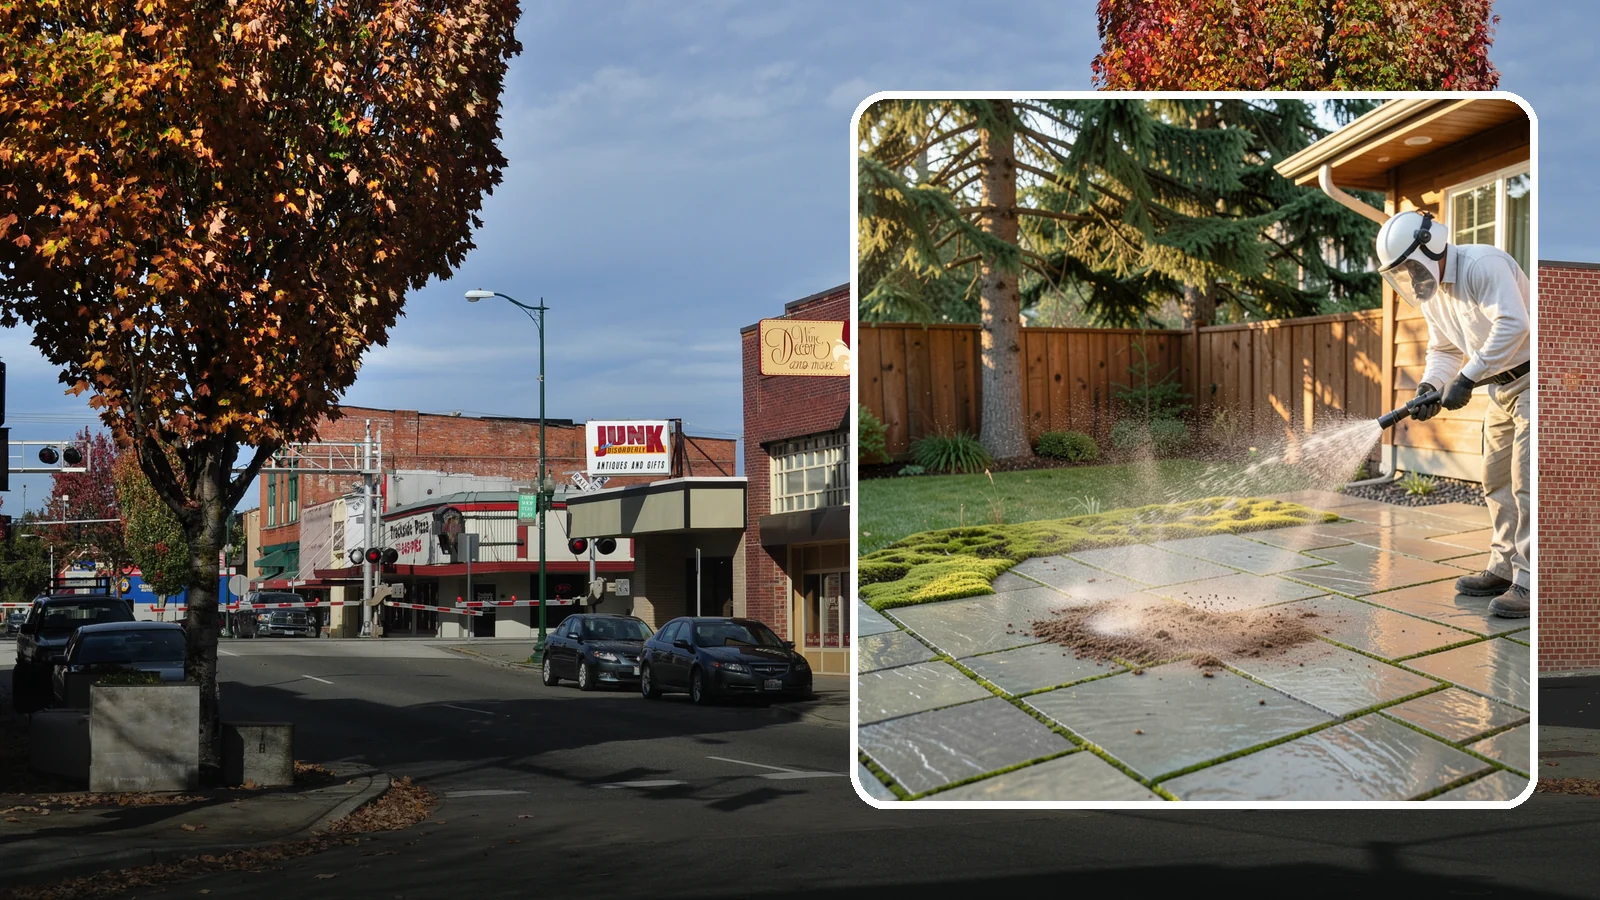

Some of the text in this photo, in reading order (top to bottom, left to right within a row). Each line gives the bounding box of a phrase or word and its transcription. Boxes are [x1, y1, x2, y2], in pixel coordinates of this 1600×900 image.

[595, 425, 665, 457] JUNK
[607, 446, 645, 454] DISORDERLY
[597, 461, 665, 470] ANTIQUES AND GIFTS
[573, 474, 589, 493] RAIL
